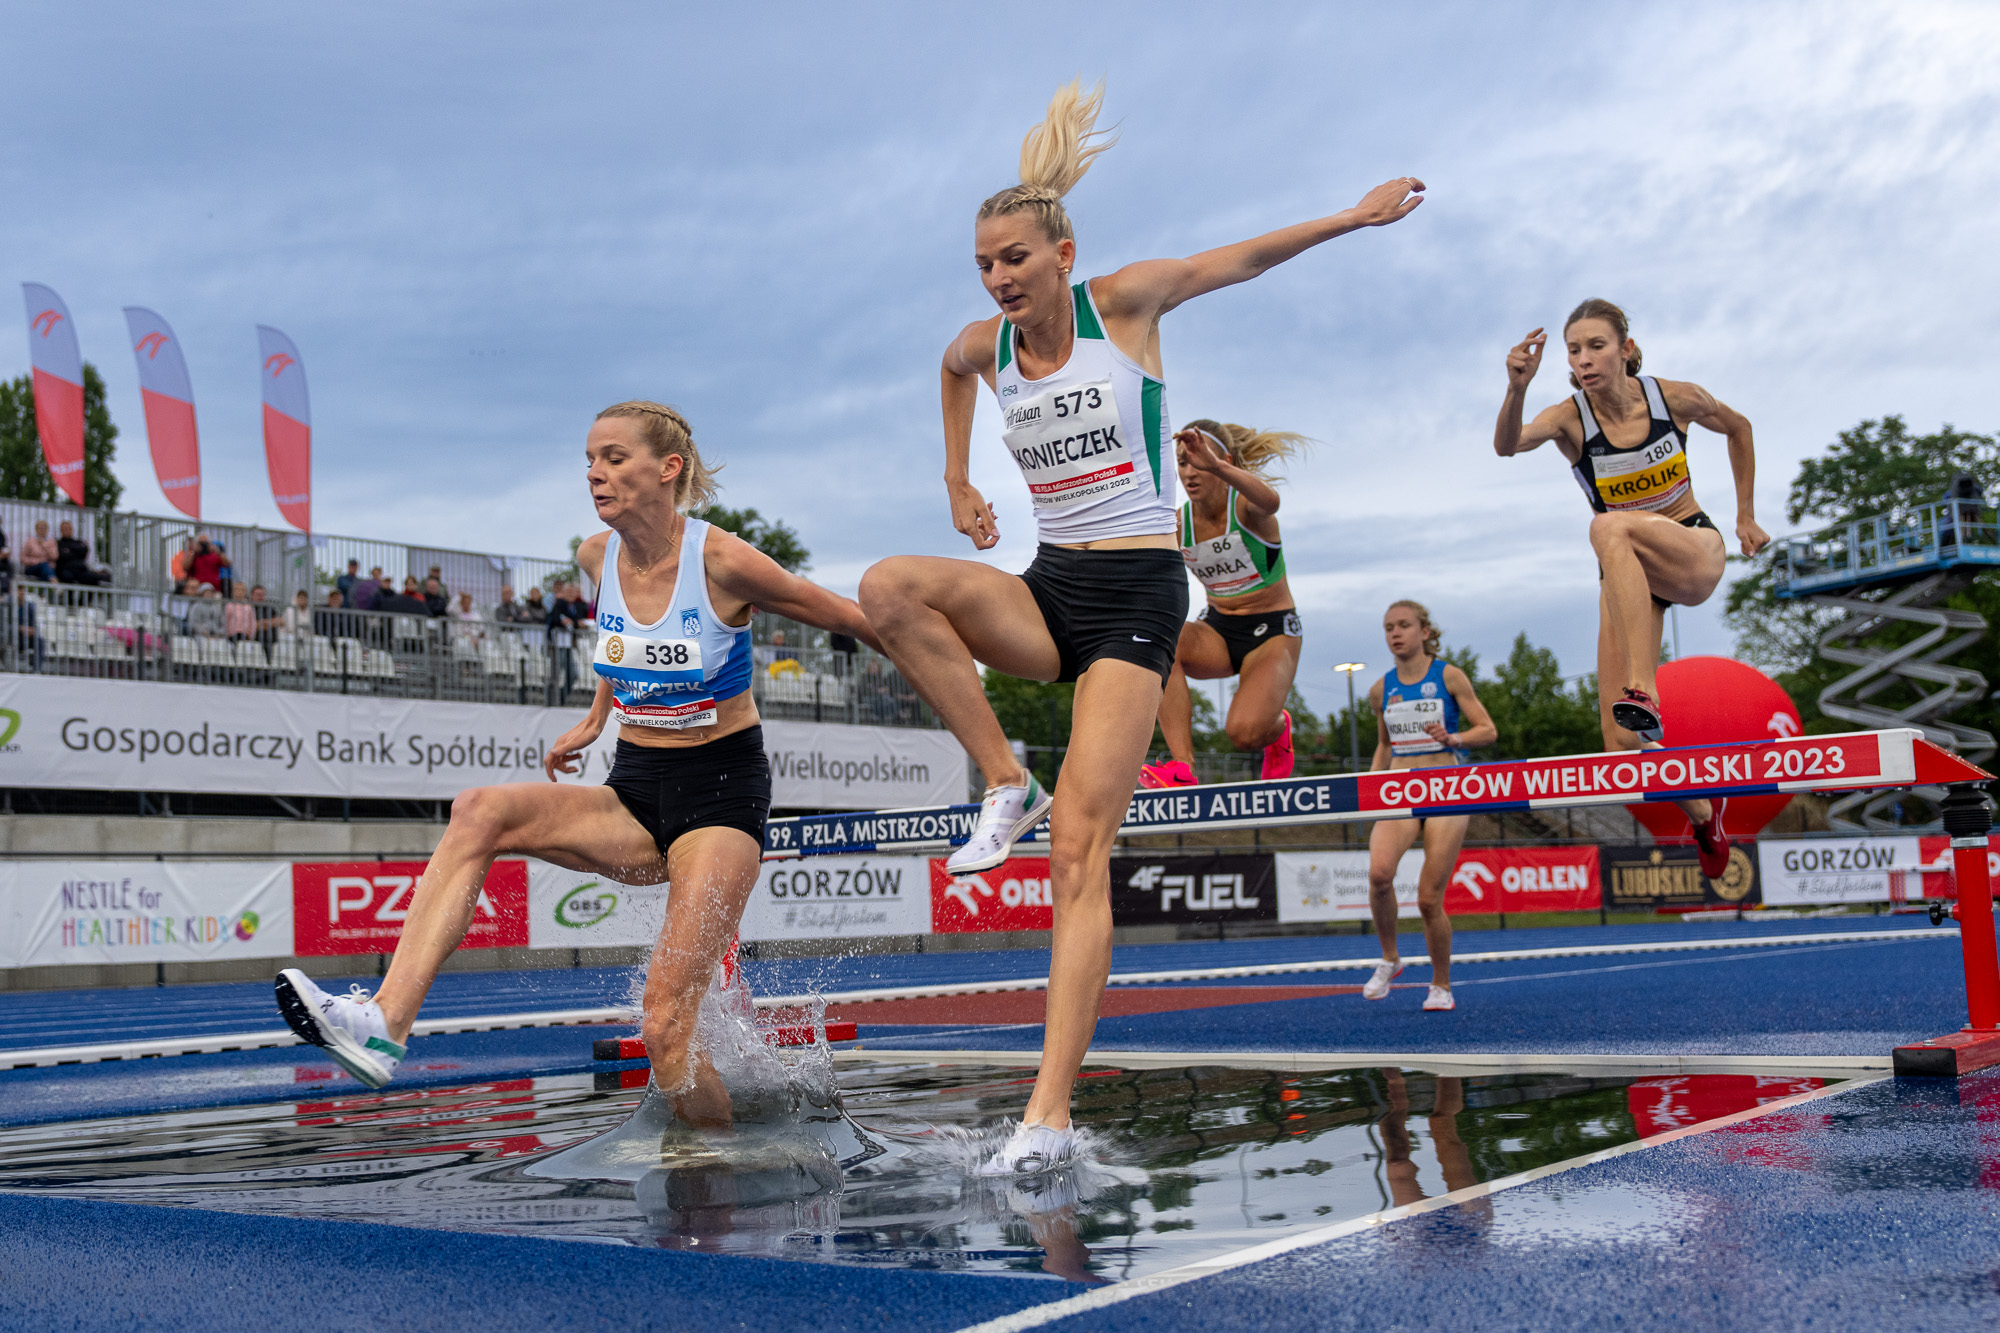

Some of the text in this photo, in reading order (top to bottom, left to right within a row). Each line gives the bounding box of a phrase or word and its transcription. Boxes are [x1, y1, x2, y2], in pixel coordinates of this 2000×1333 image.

[1054, 387, 1102, 418] 573
[1012, 425, 1123, 471] KONIECZEK
[1645, 440, 1673, 464] 180
[1094, 467, 1117, 481] Polski
[1608, 464, 1679, 497] KRÓLIK
[1054, 484, 1109, 503] WIELKOPOLSKI
[1110, 477, 1131, 489] 2023
[1212, 537, 1231, 554] 86
[600, 612, 624, 633] AZS
[645, 644, 689, 665] 538
[678, 704, 700, 715] Polski
[691, 712, 712, 721] 2023
[1414, 701, 1438, 713] 423
[61, 717, 303, 768] Gospodarczy
[316, 730, 396, 765] Bank
[408, 734, 590, 778] Spółdziely
[770, 751, 930, 787] Wielkopolskim
[769, 745, 1846, 848] 99. PZLA MISTRZOSTW EKKIEJ ATLETYCE GORZÓW WIELKOPOLSKI 2023
[1783, 841, 1895, 872] GORZÓW
[770, 861, 902, 898] GORZÓW
[1128, 866, 1165, 891] 4F
[1501, 865, 1588, 893] ORLEN
[138, 886, 162, 910] for
[1161, 873, 1260, 912] FUEL
[62, 914, 230, 947] HEALTHIER KIDS
